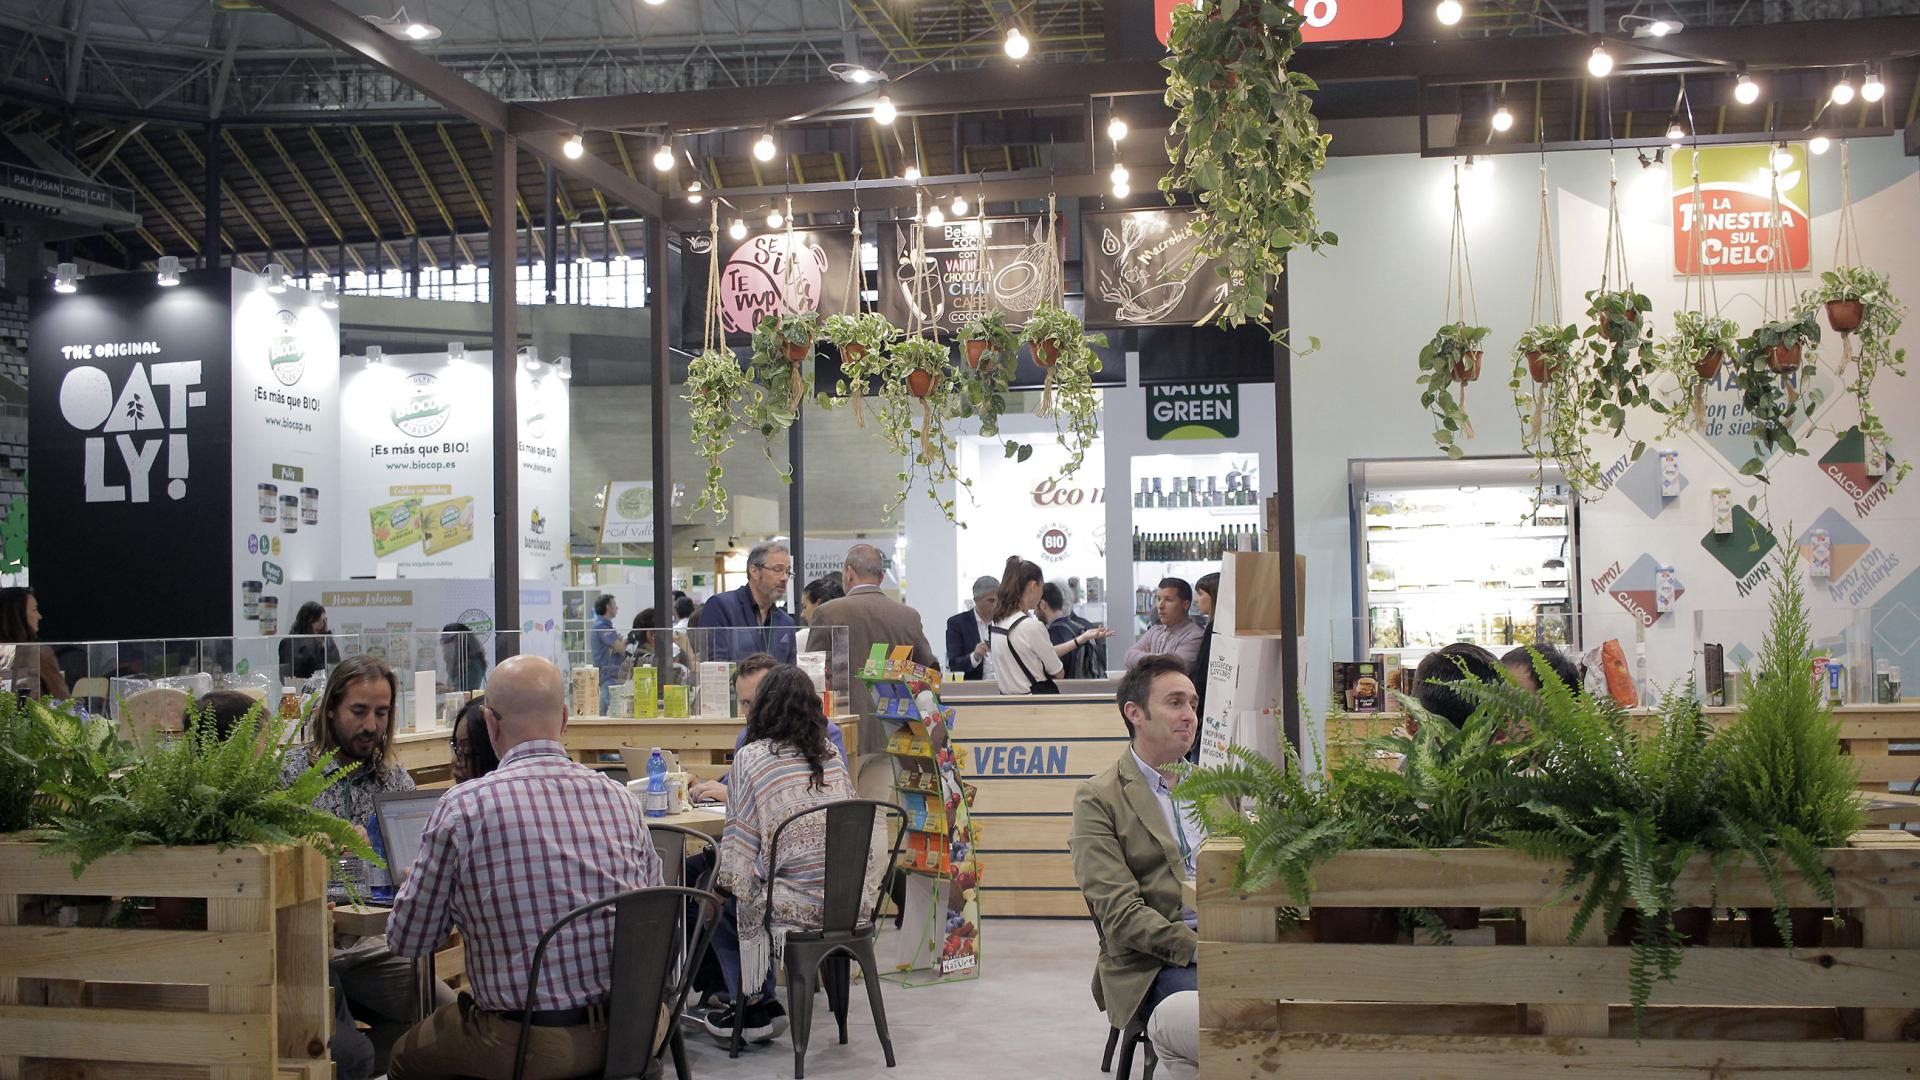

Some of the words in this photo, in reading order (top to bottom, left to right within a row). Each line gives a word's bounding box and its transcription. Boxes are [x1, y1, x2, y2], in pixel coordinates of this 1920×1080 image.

[1712, 198, 1732, 210] LA
[1679, 203, 1795, 231] FINESTRA
[1730, 232, 1759, 244] SUL
[1700, 238, 1775, 265] CIELO
[61, 345, 93, 360] THE
[94, 341, 162, 359] ORIGINAL
[269, 389, 285, 404] más
[286, 395, 302, 411] que
[303, 396, 321, 412] BIO!
[1153, 400, 1232, 422] GREEN
[265, 416, 312, 434] www.biocop.es
[1705, 418, 1723, 436] de
[371, 443, 389, 459] ¡Es
[391, 443, 416, 456] más
[418, 446, 440, 460] que
[442, 442, 470, 454] BIO!
[84, 433, 190, 503] LY!
[386, 459, 456, 472] www.biocop.es
[1827, 466, 1864, 499] CALCIO
[1854, 481, 1888, 519] Avena
[1045, 535, 1064, 549] BIO
[1040, 550, 1071, 562] ORGANIC
[1590, 560, 1625, 595] Arroz
[1735, 560, 1772, 598] Avena
[1828, 569, 1860, 602] Arroz
[1860, 546, 1884, 570] con
[1848, 552, 1900, 606] avellanas
[1209, 661, 1232, 673] HIGHER
[1209, 668, 1231, 680] LIVING
[974, 745, 1069, 775] VEGAN
